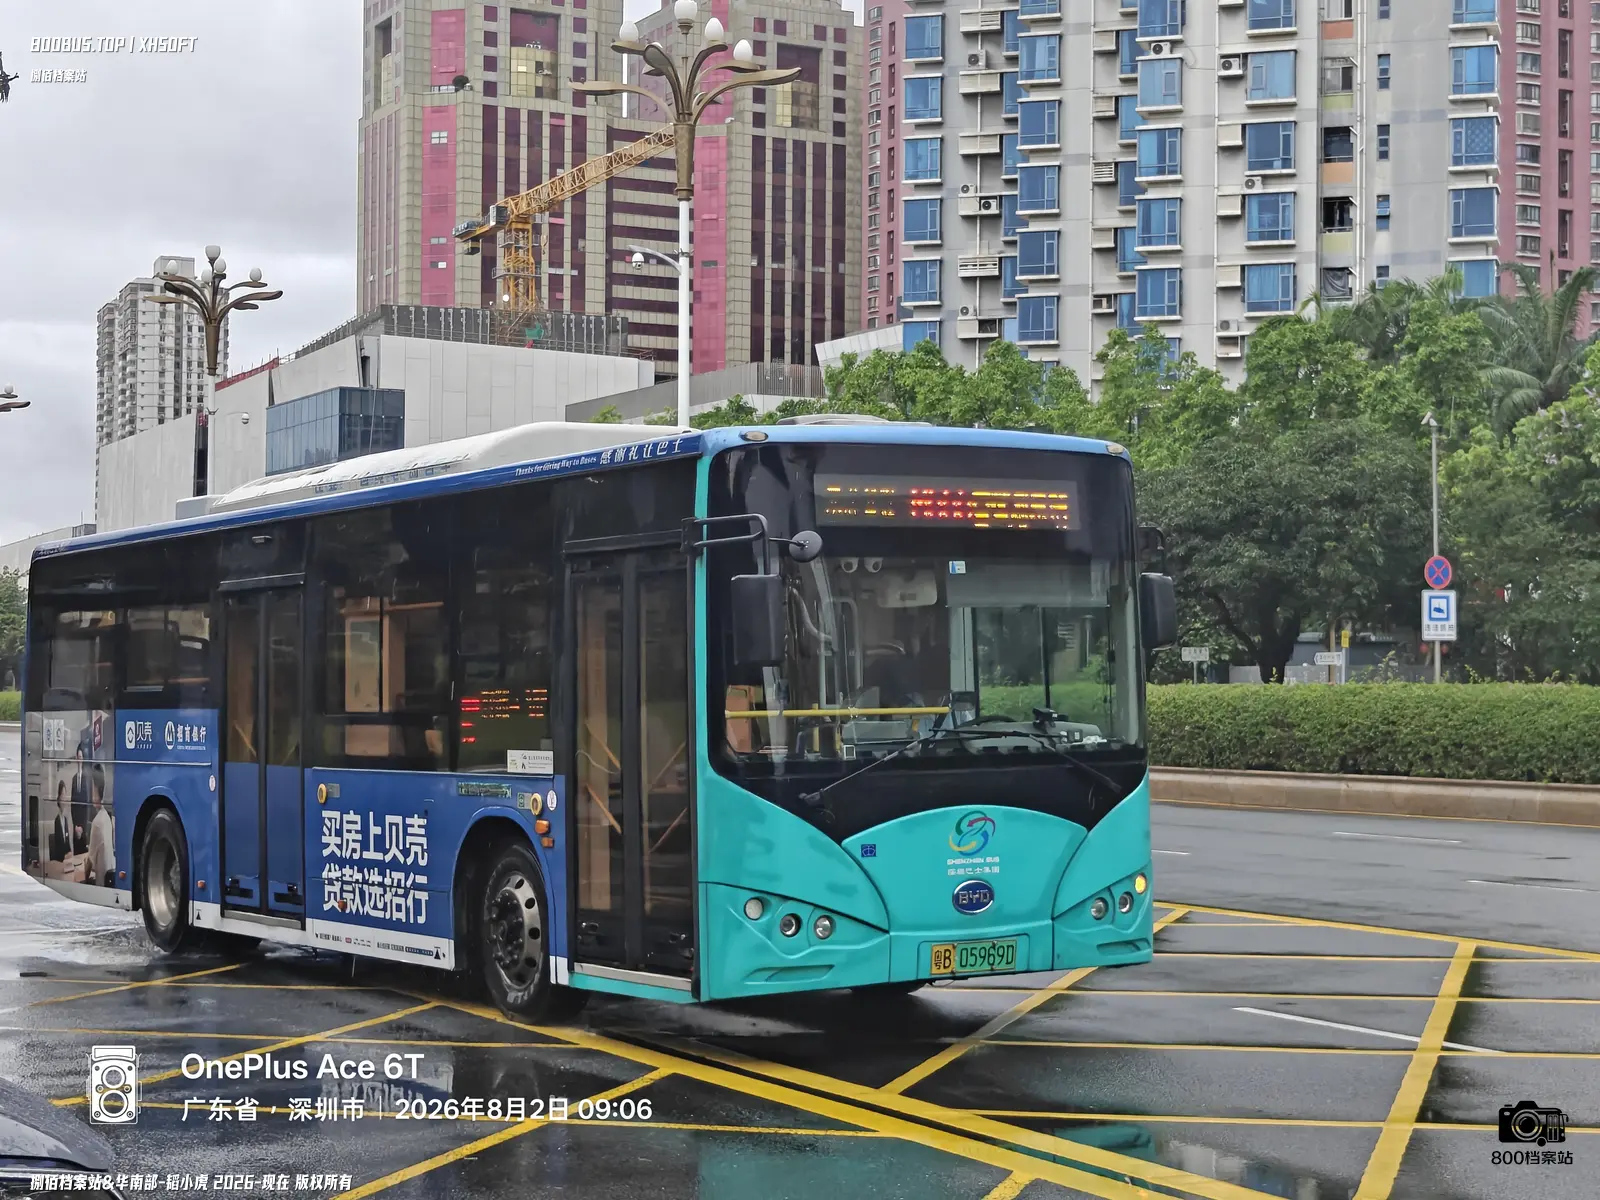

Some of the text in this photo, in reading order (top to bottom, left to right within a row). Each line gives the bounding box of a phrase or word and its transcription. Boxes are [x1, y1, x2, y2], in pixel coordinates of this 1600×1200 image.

[600, 437, 683, 465] 感谢礼让巴士
[515, 467, 533, 476] Thanks
[534, 465, 542, 473] for
[580, 457, 597, 465] Buses
[321, 810, 428, 866] 买房上贝壳
[322, 863, 429, 924] 贷款选招行
[959, 889, 990, 904] BYD
